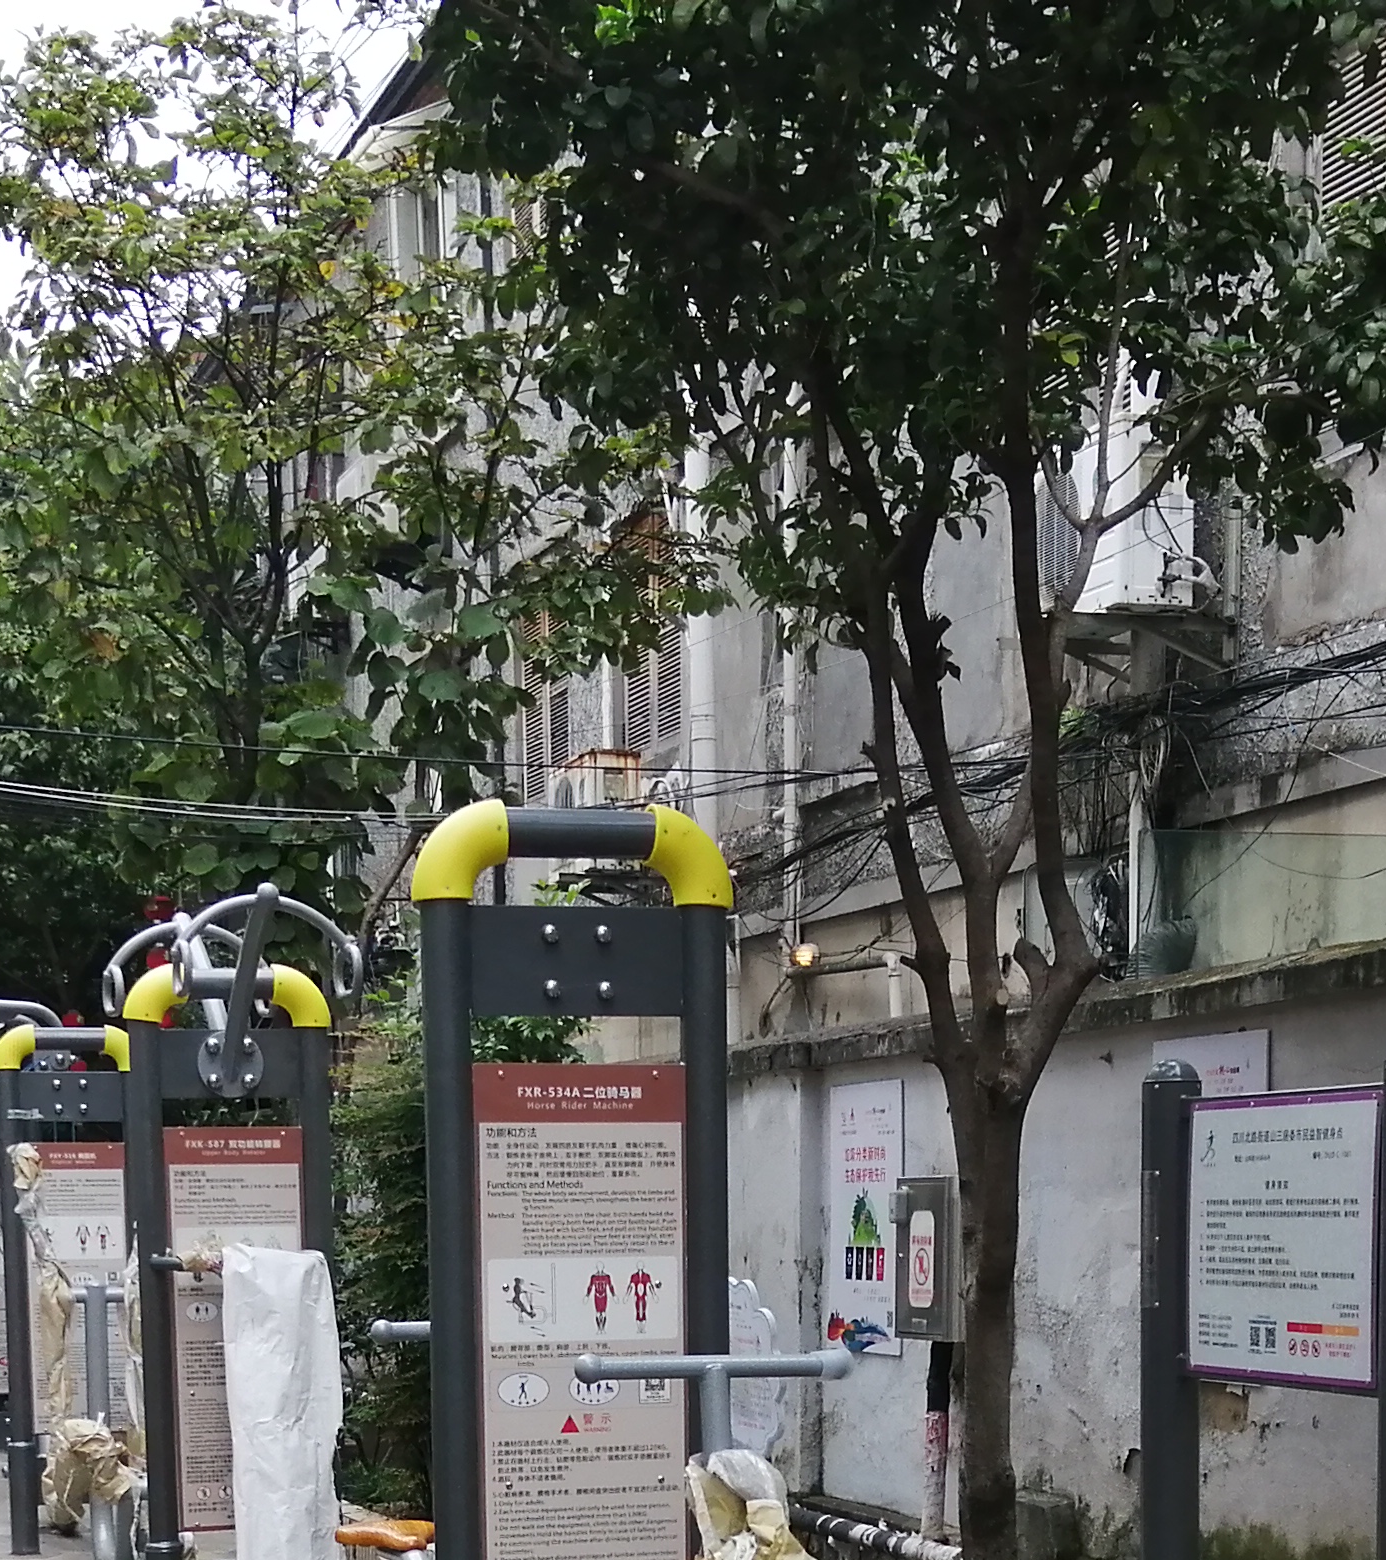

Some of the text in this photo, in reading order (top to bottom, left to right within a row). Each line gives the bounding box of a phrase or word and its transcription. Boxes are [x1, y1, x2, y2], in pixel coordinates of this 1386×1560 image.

[527, 1101, 634, 1110] Horse Rider Machine
[485, 1127, 537, 1138] 功能和方法
[486, 1179, 583, 1190] Functions and Methods
